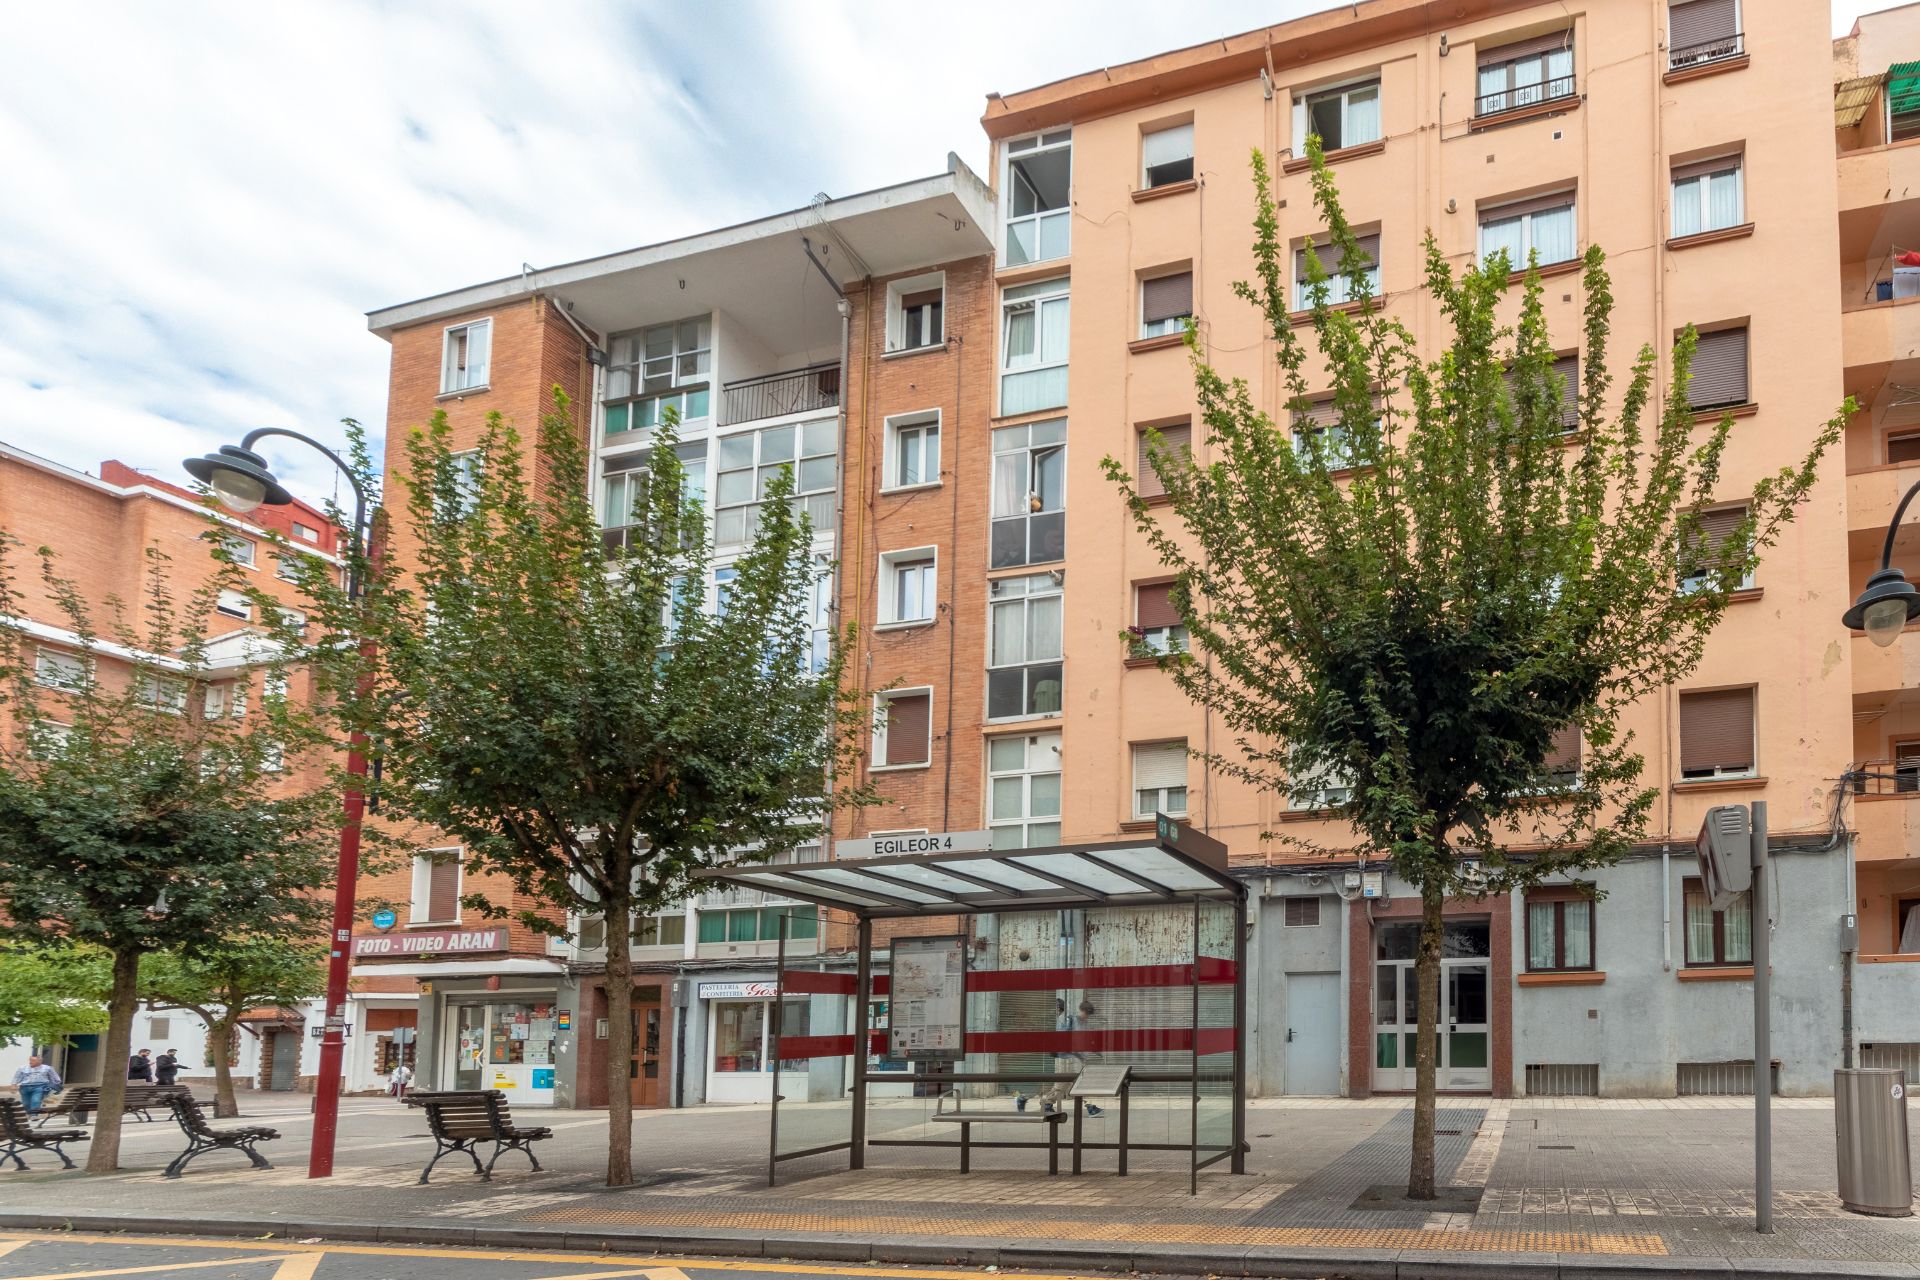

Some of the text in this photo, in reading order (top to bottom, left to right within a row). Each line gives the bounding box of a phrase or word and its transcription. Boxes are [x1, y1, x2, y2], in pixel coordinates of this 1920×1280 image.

[875, 837, 952, 854] EGILEOR 4
[356, 939, 391, 954] FOTO
[402, 937, 444, 952] VIDEO
[447, 931, 496, 950] ARAN
